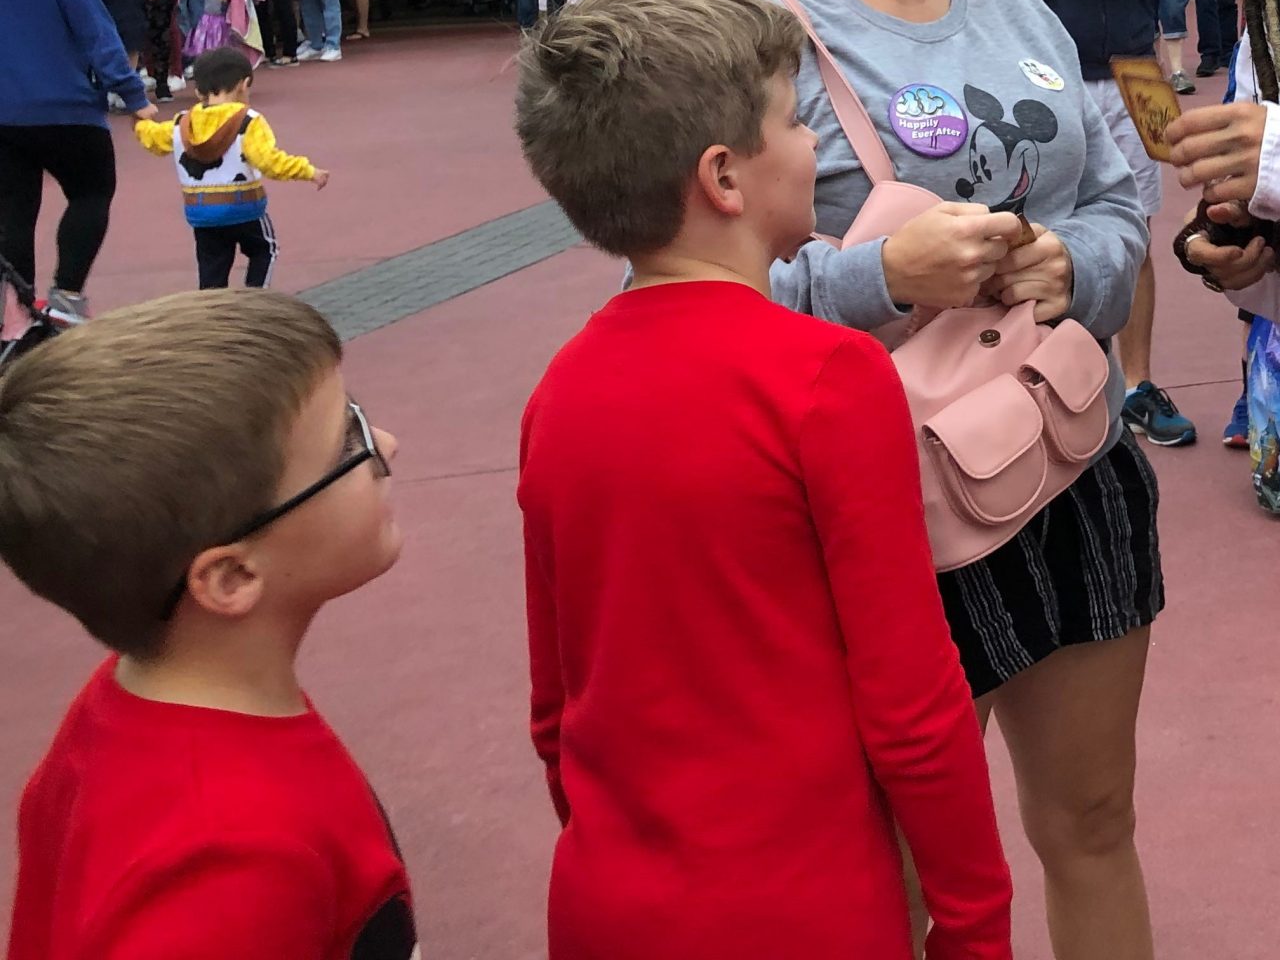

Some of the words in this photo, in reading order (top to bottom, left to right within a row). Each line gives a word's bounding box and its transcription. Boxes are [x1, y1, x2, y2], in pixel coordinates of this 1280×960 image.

[898, 119, 940, 130] Happily
[911, 129, 935, 139] Ever
[935, 128, 961, 137] After
